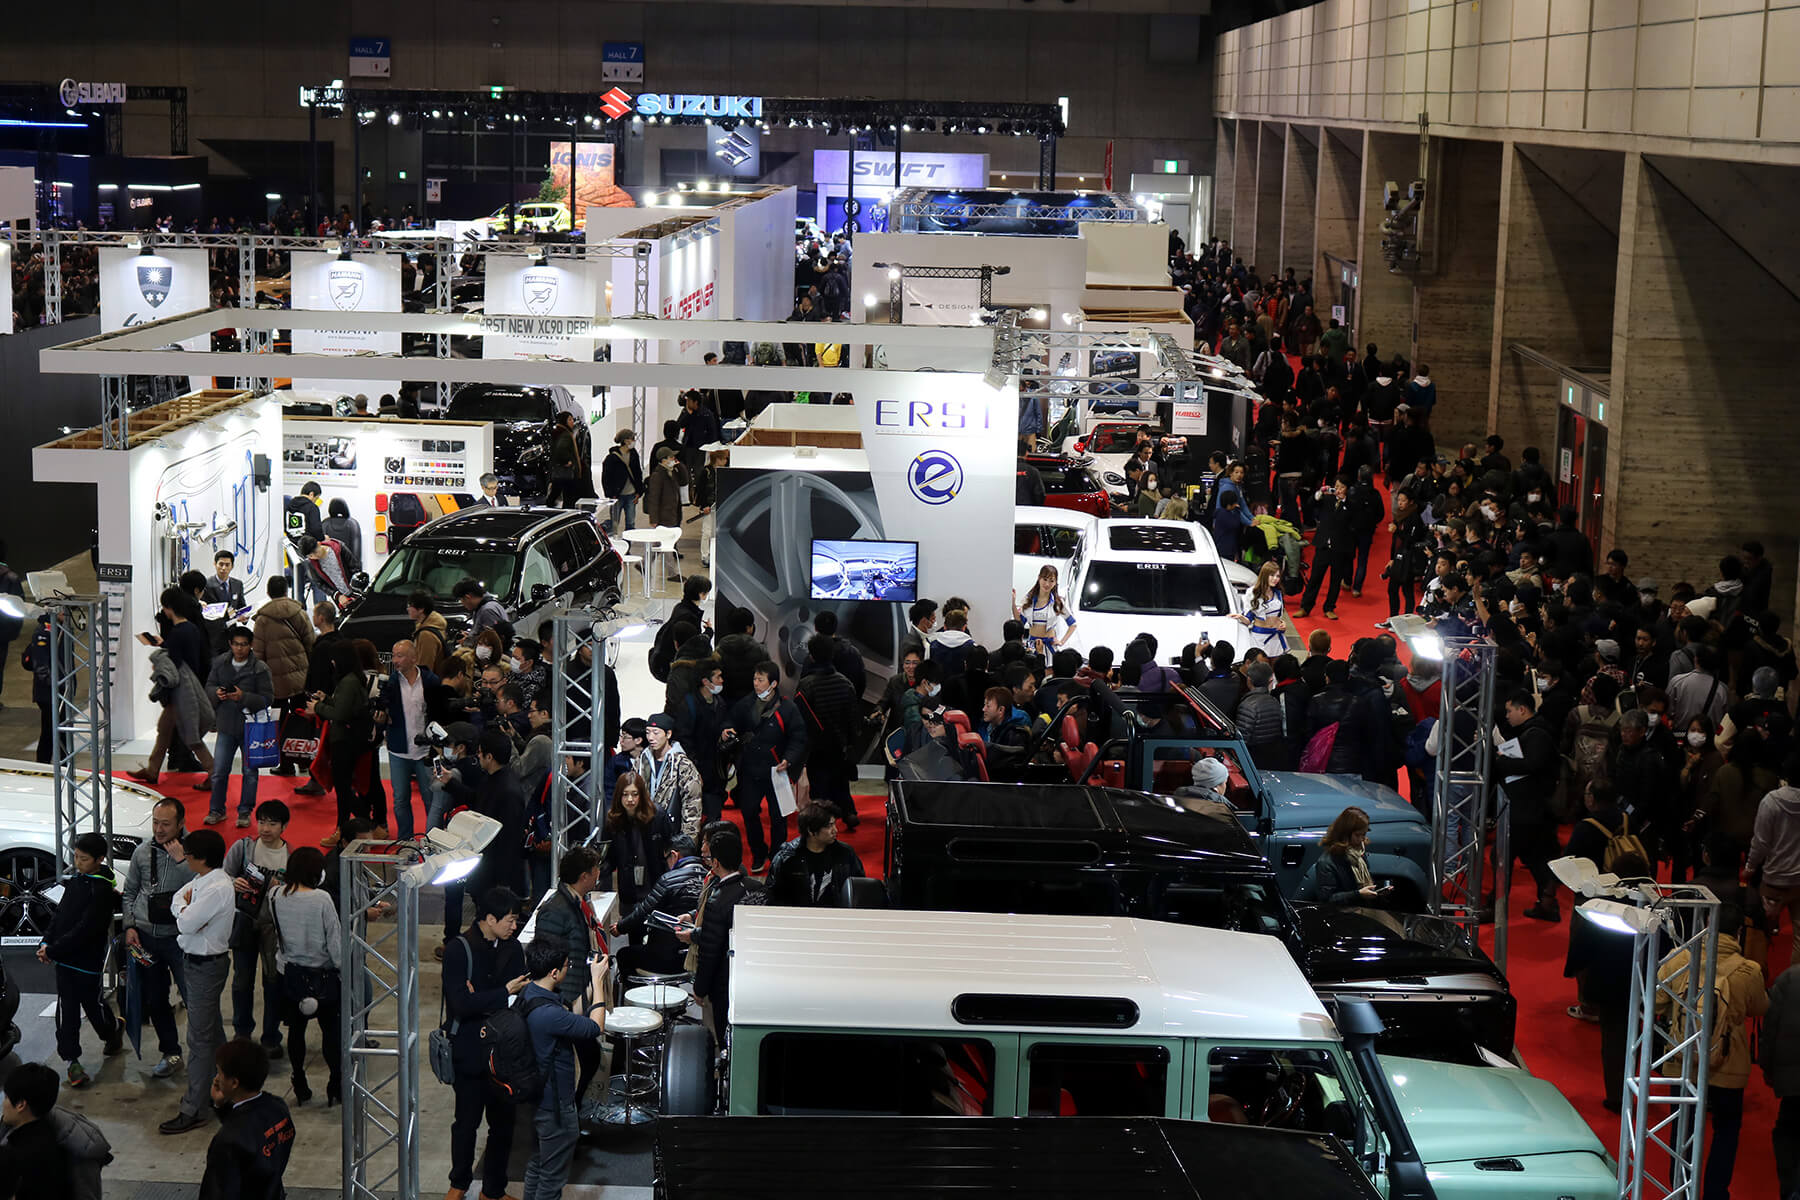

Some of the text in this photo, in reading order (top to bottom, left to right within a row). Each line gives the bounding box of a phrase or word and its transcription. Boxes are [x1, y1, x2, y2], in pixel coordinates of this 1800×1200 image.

[376, 42, 384, 54] 7
[629, 47, 638, 59] 7
[79, 83, 126, 103] SUBARU
[637, 93, 762, 117] SUZUKI
[552, 151, 612, 167] IGNIS
[330, 271, 362, 280] HAMANN
[509, 319, 533, 333] NEW
[539, 320, 563, 335] XC90
[99, 567, 129, 577] ERST
[1136, 563, 1168, 571] ERST
